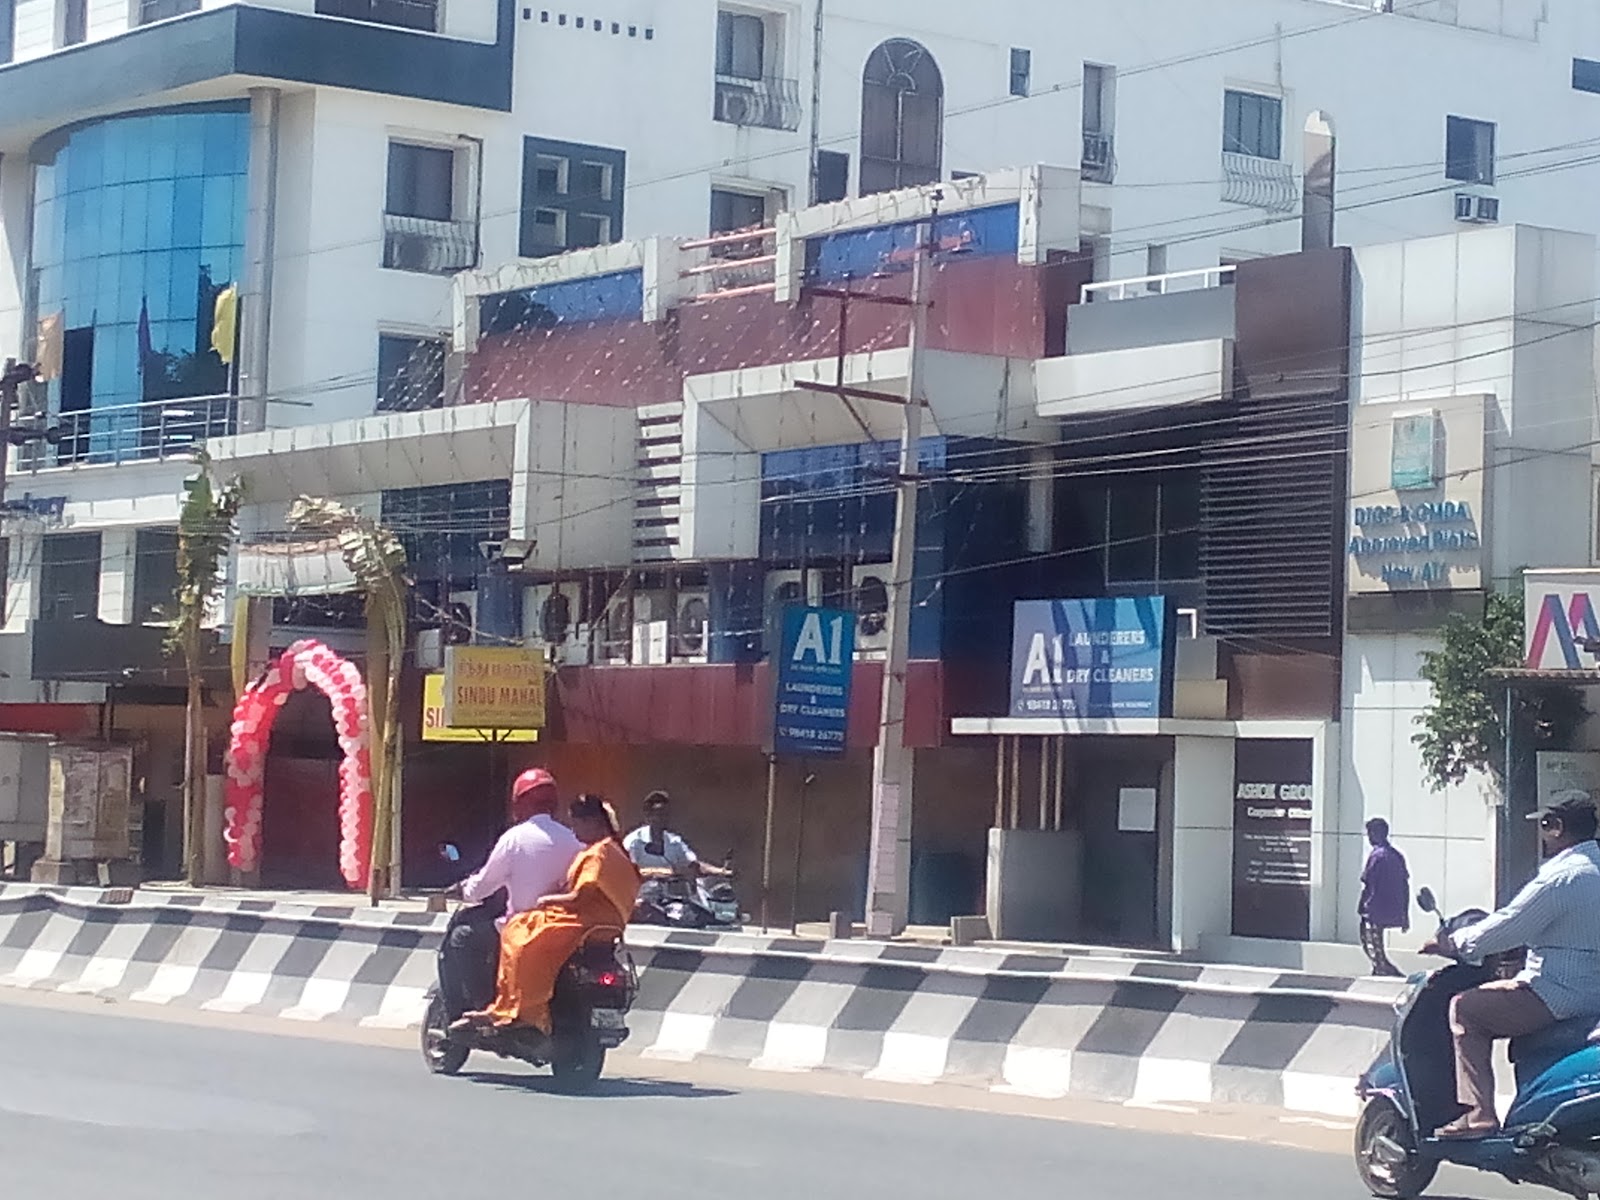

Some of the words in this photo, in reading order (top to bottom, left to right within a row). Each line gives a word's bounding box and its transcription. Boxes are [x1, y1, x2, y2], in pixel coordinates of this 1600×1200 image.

[793, 613, 842, 664] A1
[1022, 633, 1063, 685] A1
[1066, 668, 1090, 683] DRY
[1093, 667, 1154, 683] CLEANERS
[458, 686, 495, 705] SINDU
[500, 686, 541, 705] MAHAL
[780, 703, 799, 714] DRY
[801, 705, 845, 718] CLEANERS
[1237, 783, 1276, 799] ASHOK
